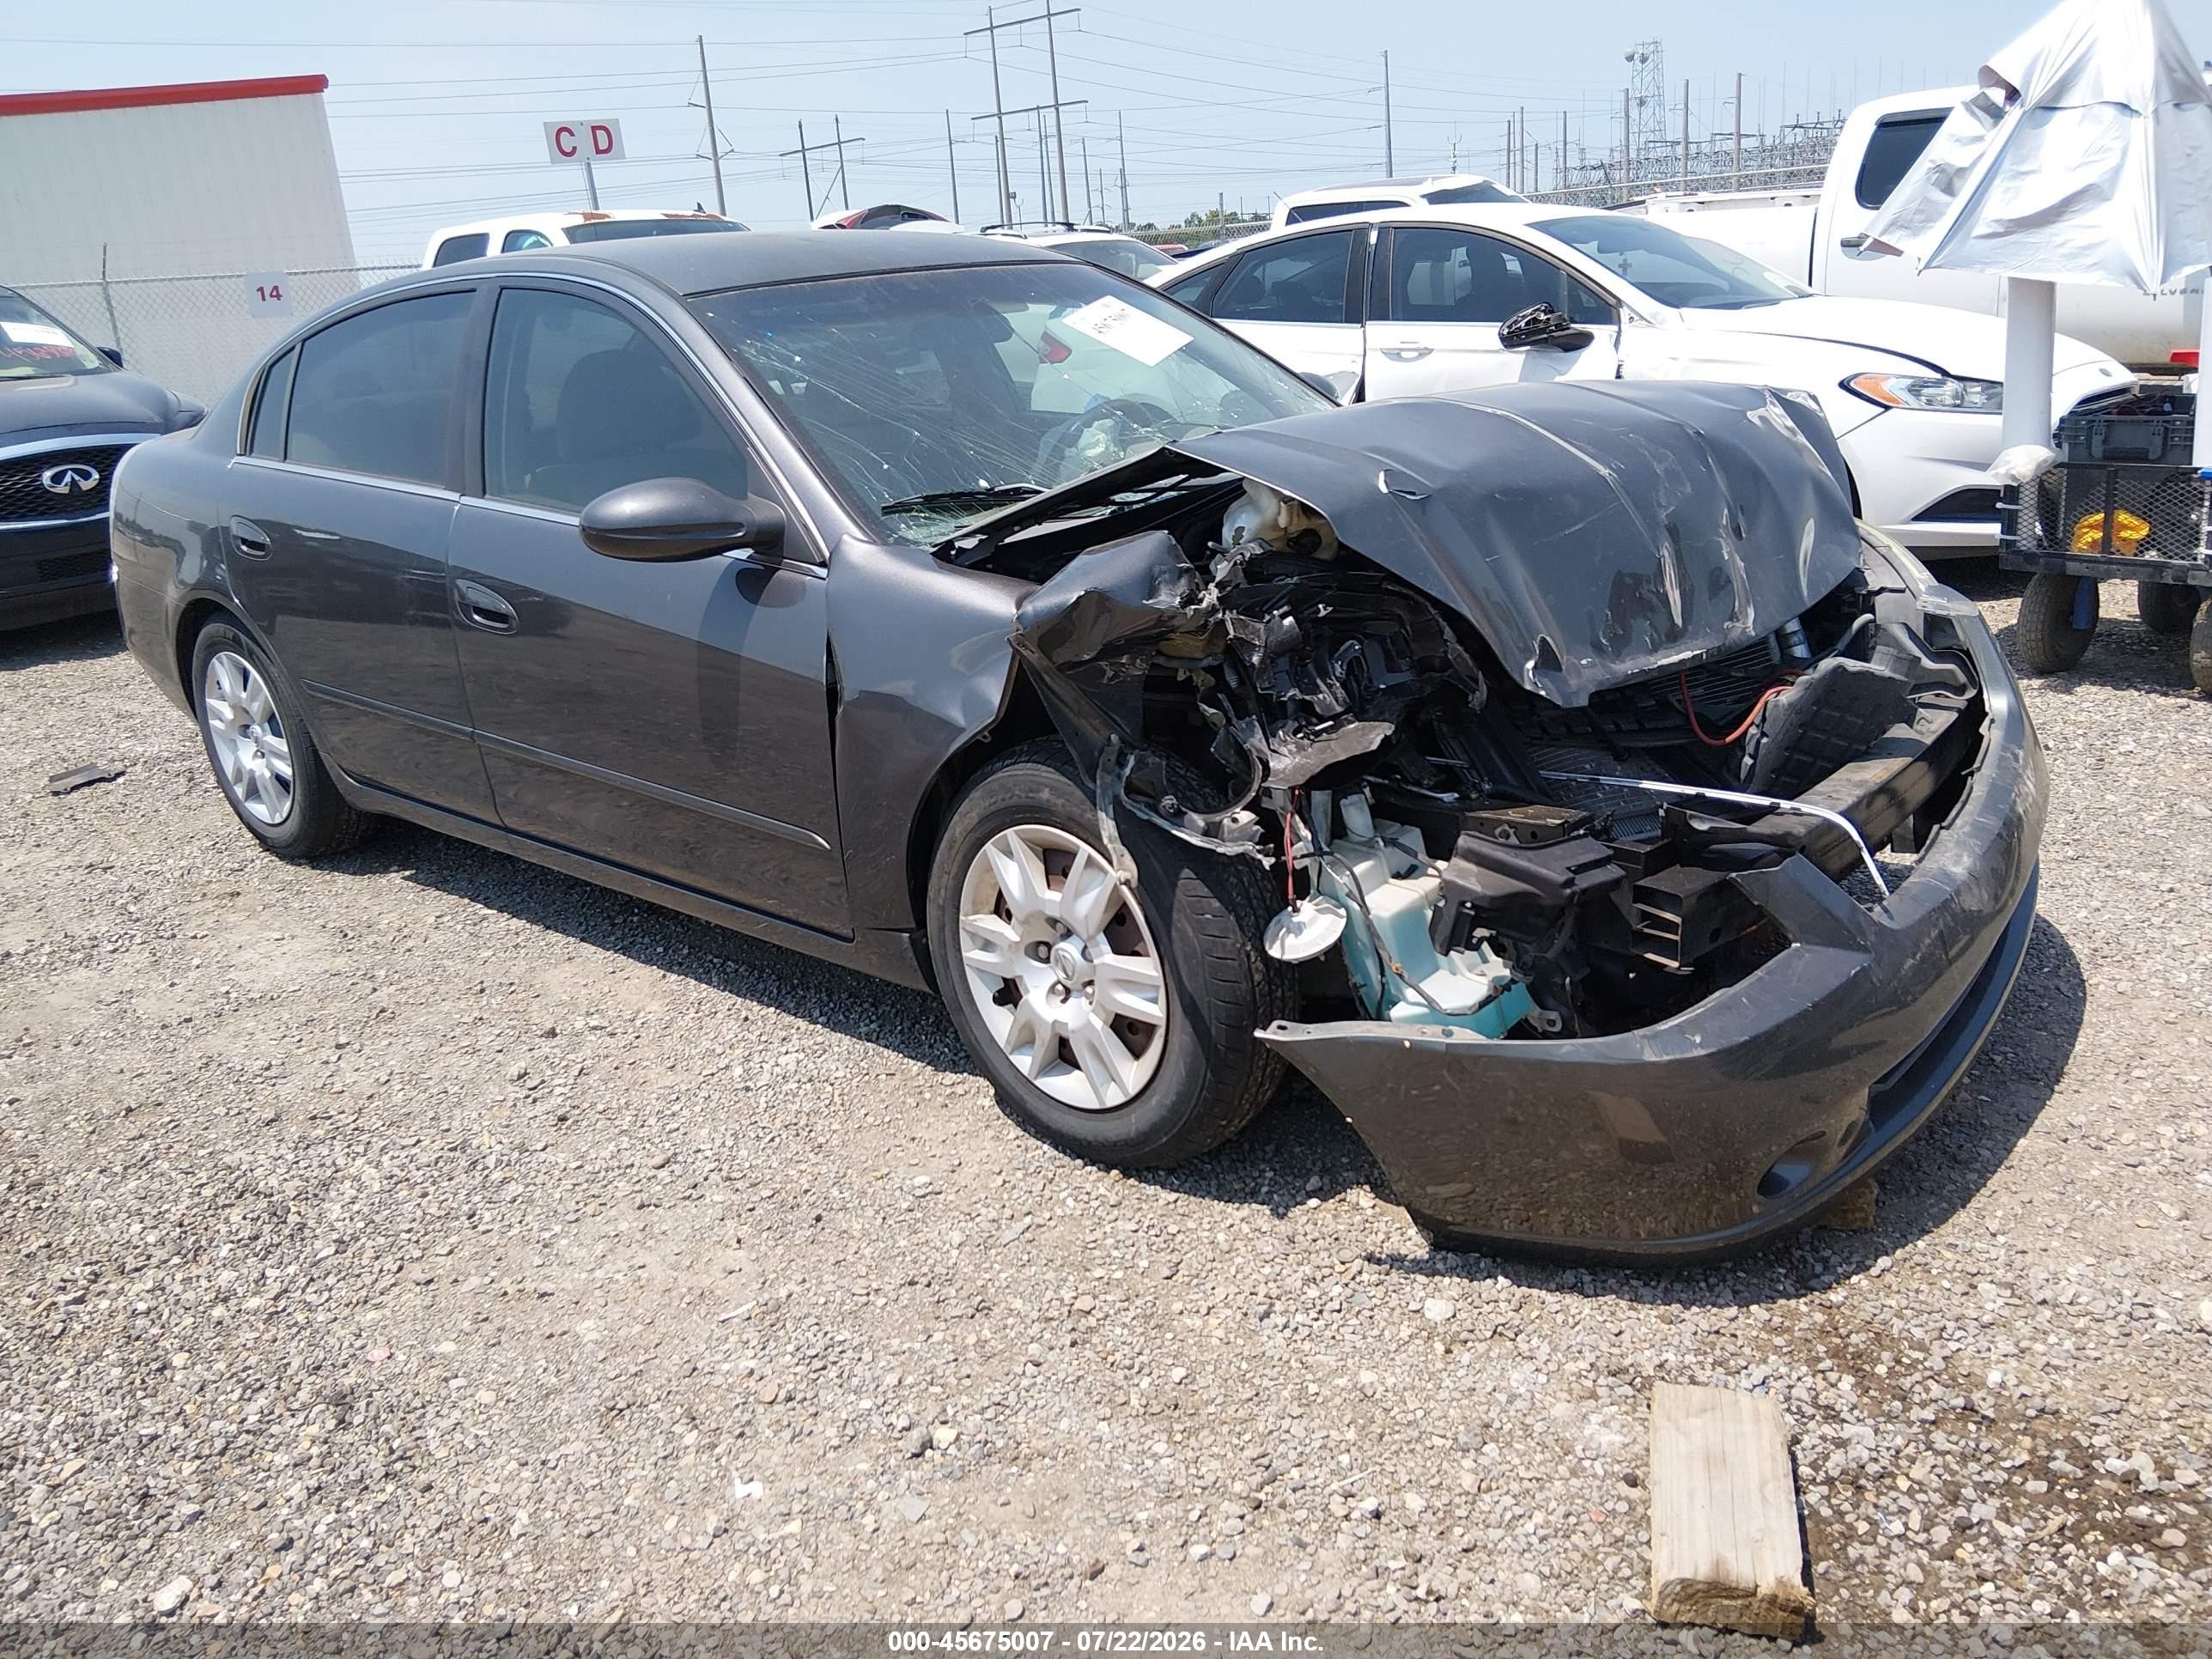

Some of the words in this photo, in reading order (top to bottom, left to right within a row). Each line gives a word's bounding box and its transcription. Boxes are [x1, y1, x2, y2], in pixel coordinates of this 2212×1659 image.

[554, 126, 578, 158] C
[590, 125, 614, 155] D
[256, 284, 283, 302] 14
